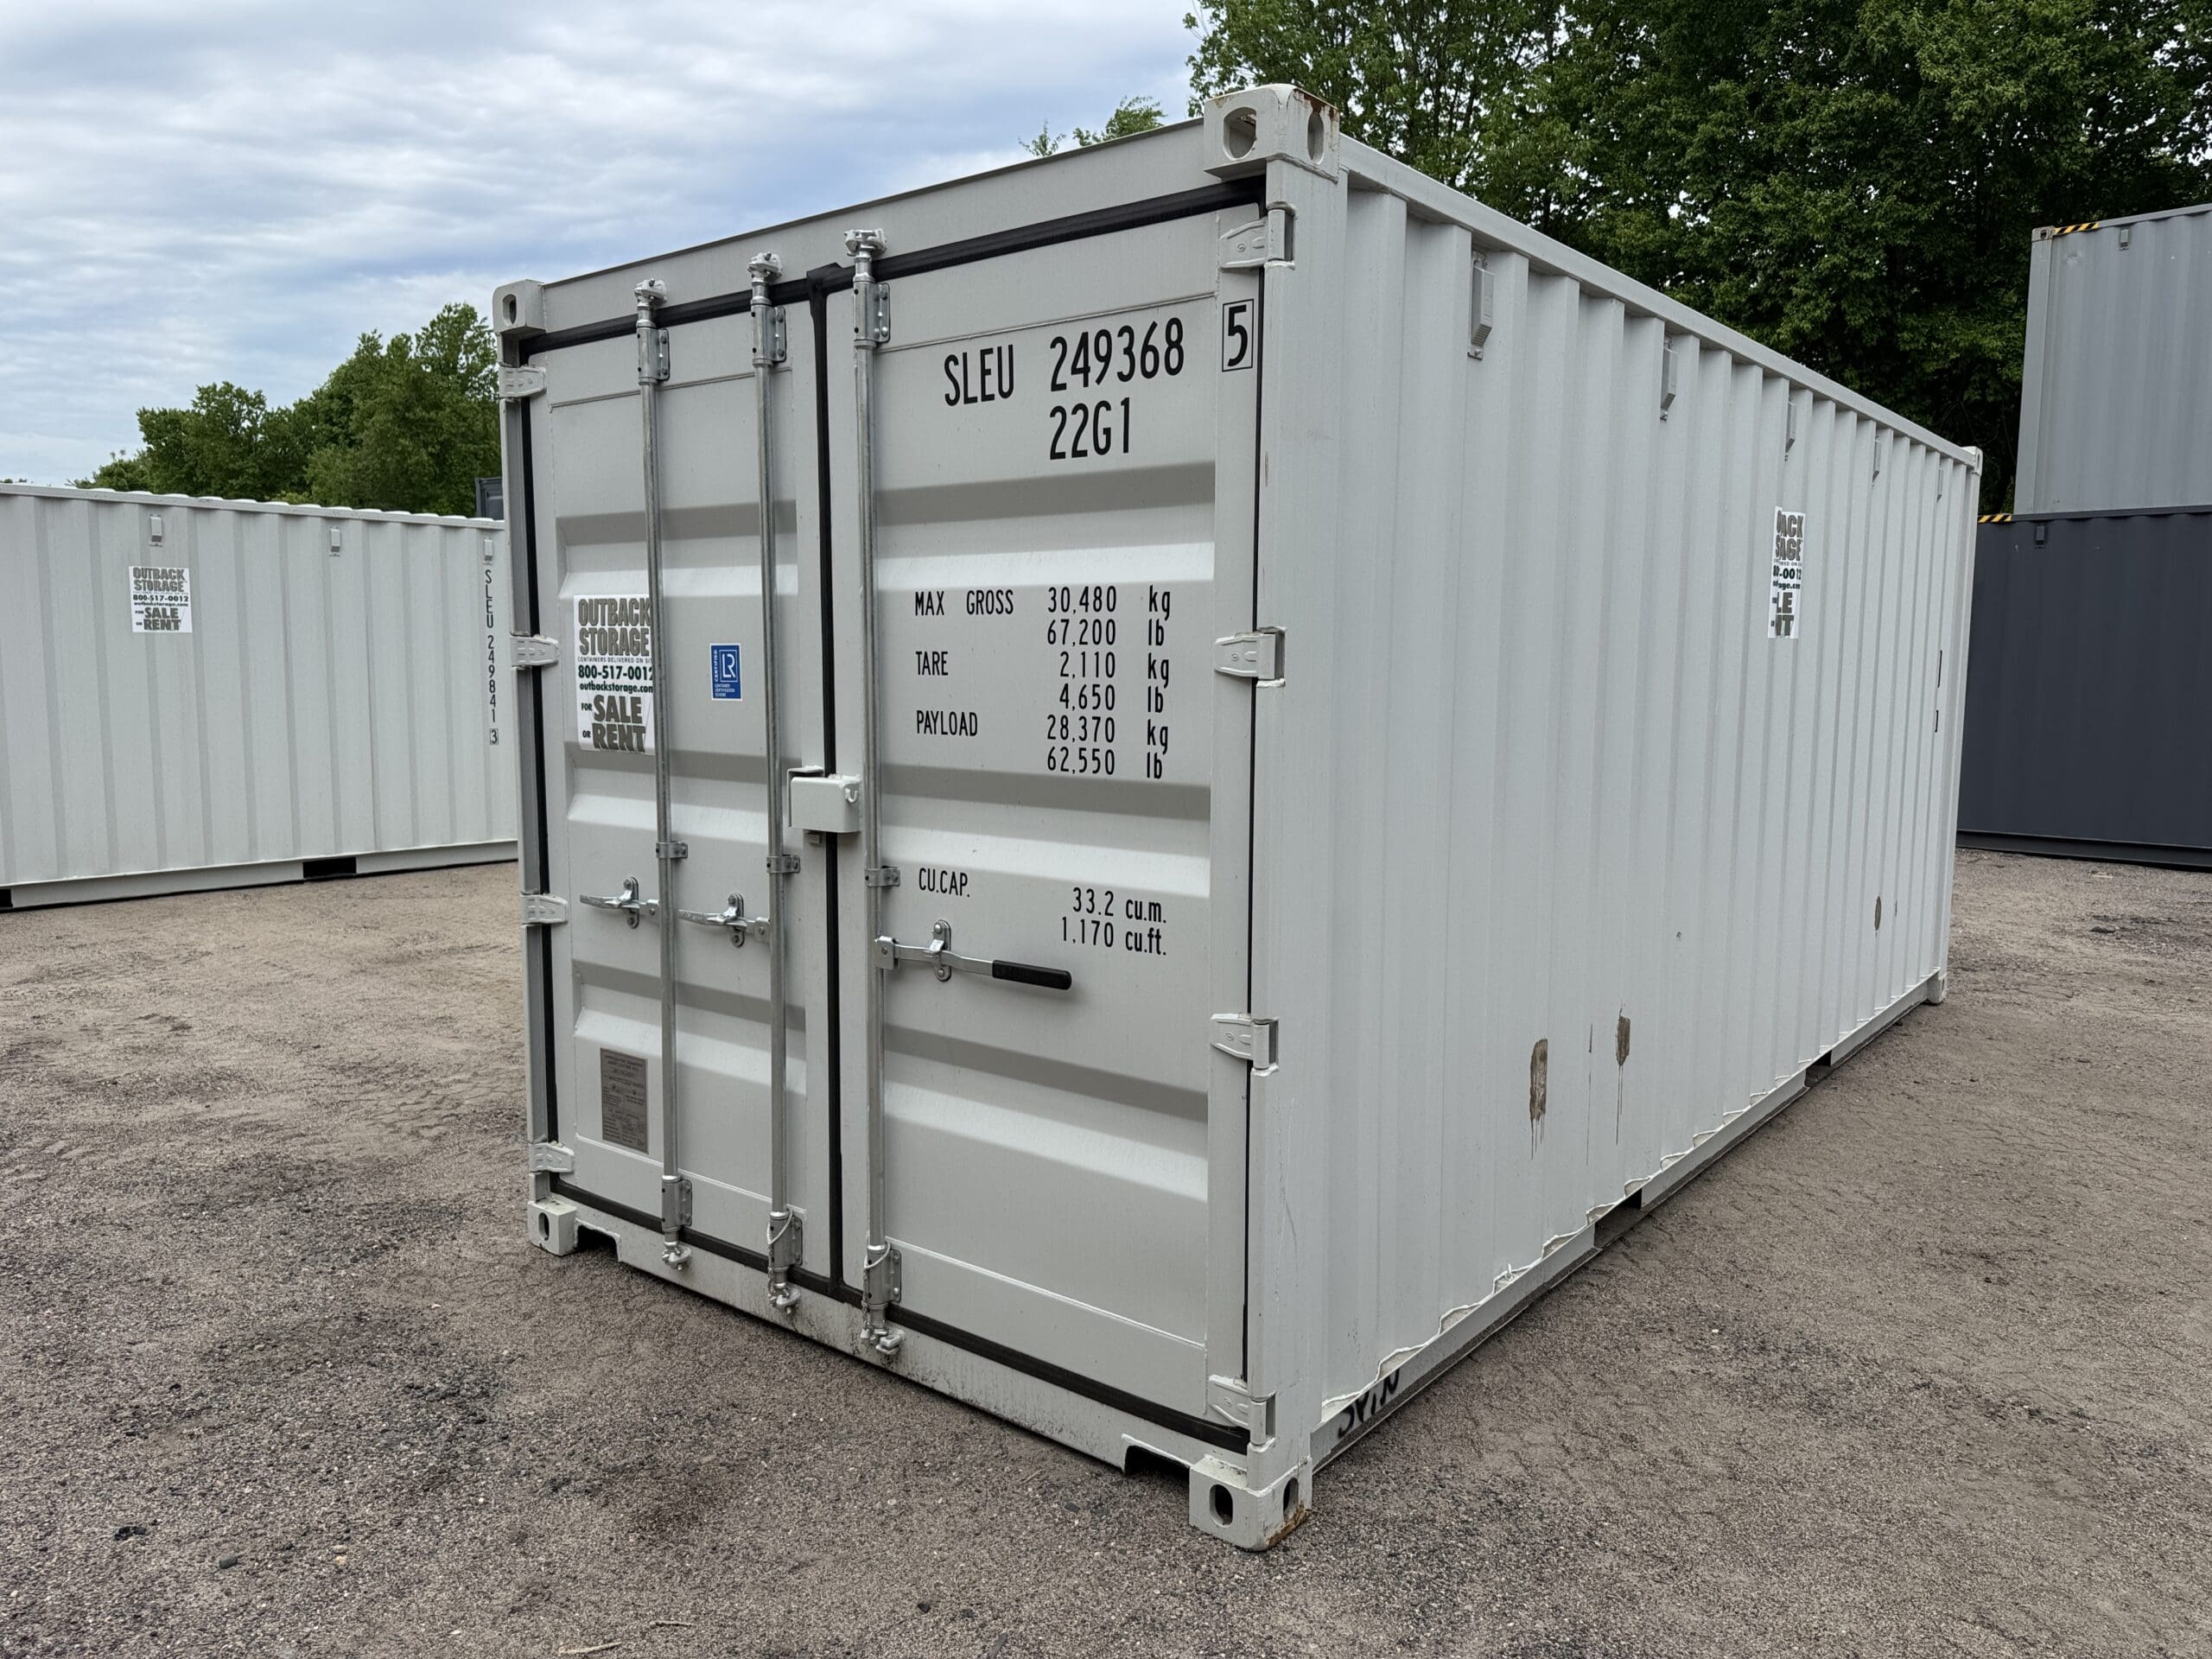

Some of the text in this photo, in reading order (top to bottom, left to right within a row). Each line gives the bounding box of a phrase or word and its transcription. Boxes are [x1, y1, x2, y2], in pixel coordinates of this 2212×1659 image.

[944, 304, 1249, 406] SLEU 249368 5
[1049, 397, 1130, 461] 22G1
[132, 567, 186, 581] OUTBACK
[133, 580, 184, 592] STORAGE
[144, 607, 179, 619] SALE
[485, 569, 494, 629] SLEU
[578, 598, 650, 626] OUTBACK
[915, 585, 1170, 620] MAX GROSS 30,480 kg
[143, 619, 181, 631] RENT
[1047, 619, 1165, 646] 67,200 lb
[579, 627, 650, 657] STORAGE
[487, 635, 497, 723] 249841
[721, 653, 736, 678] LR
[916, 652, 1169, 689] TARE 2,110 kg
[594, 695, 642, 724] SALE
[1059, 683, 1164, 713] 4,650 lb
[592, 723, 646, 753] RENT
[916, 710, 1168, 755] PAYLOAD 28,370 kg
[1047, 747, 1163, 779] 62,550 lb
[918, 868, 1167, 924] CU.CAP. 33.2 cu.m.
[1125, 927, 1167, 956] cu.ft.
